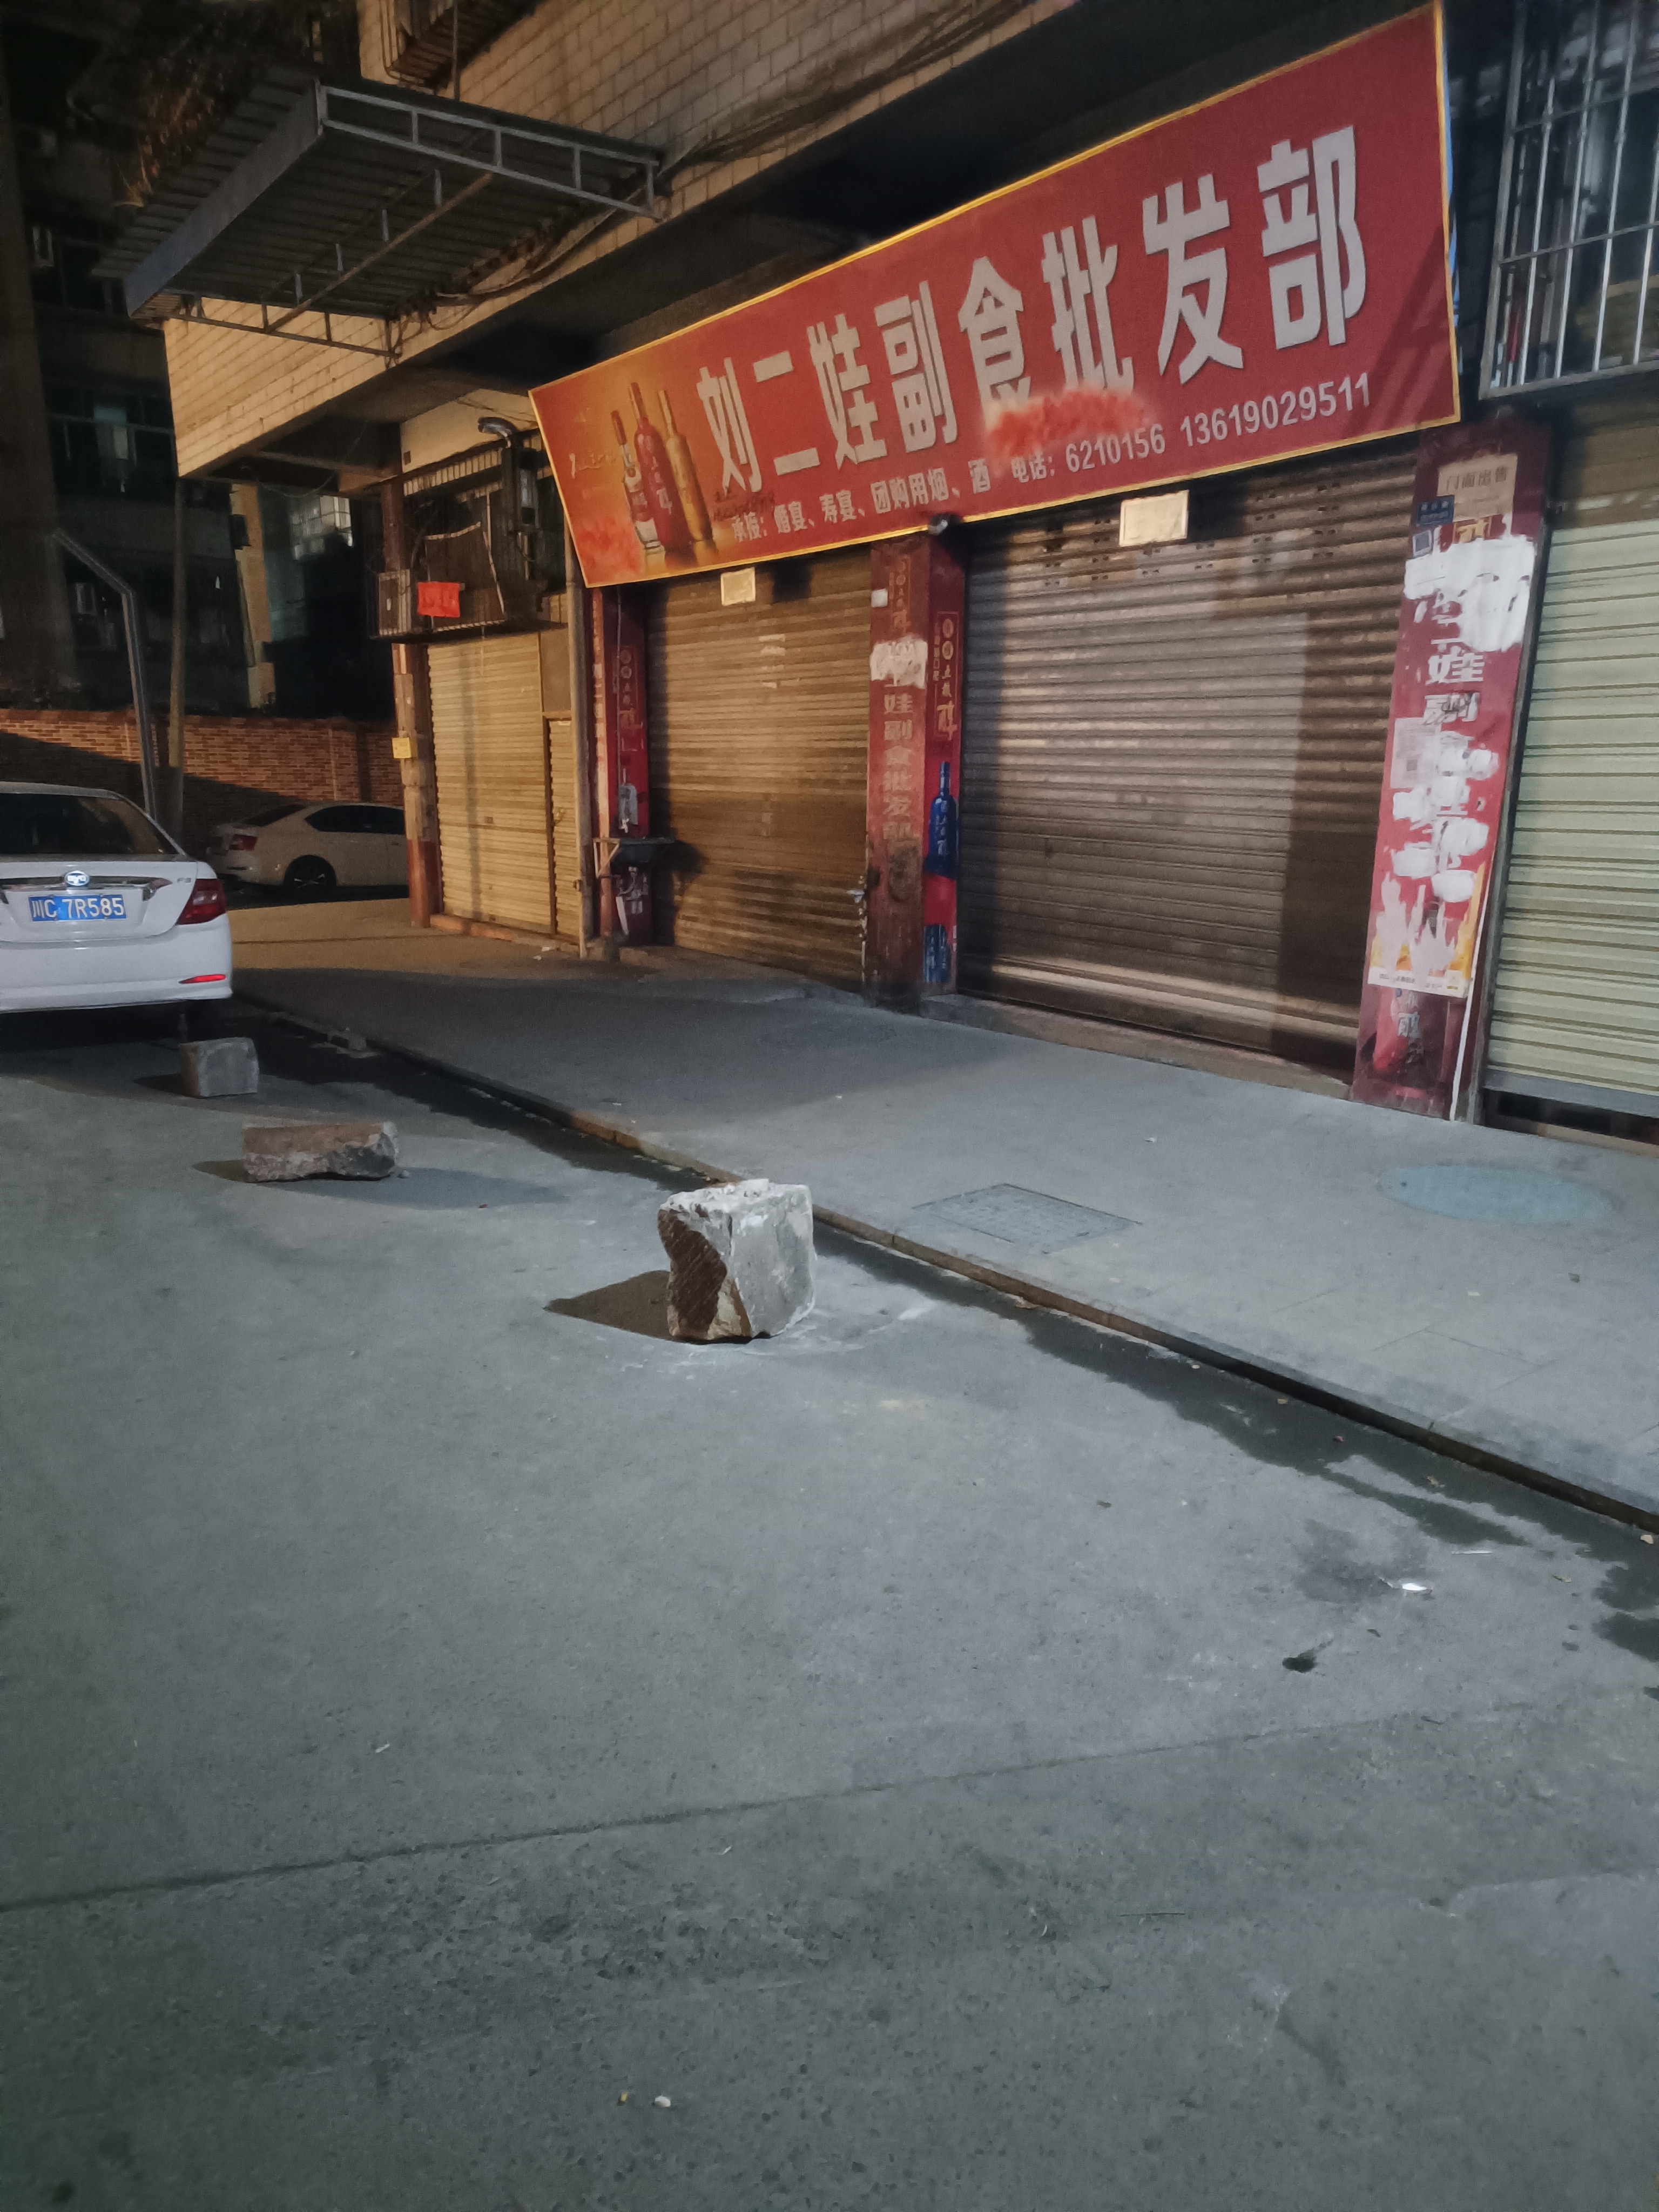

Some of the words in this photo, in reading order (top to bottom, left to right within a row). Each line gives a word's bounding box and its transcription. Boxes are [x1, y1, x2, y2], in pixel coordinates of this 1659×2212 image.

[697, 126, 1367, 495] 刘二娃副食批发部
[1065, 423, 1165, 473] 6210156
[1180, 373, 1370, 447] 13619029511
[62, 897, 124, 919] 7R585
